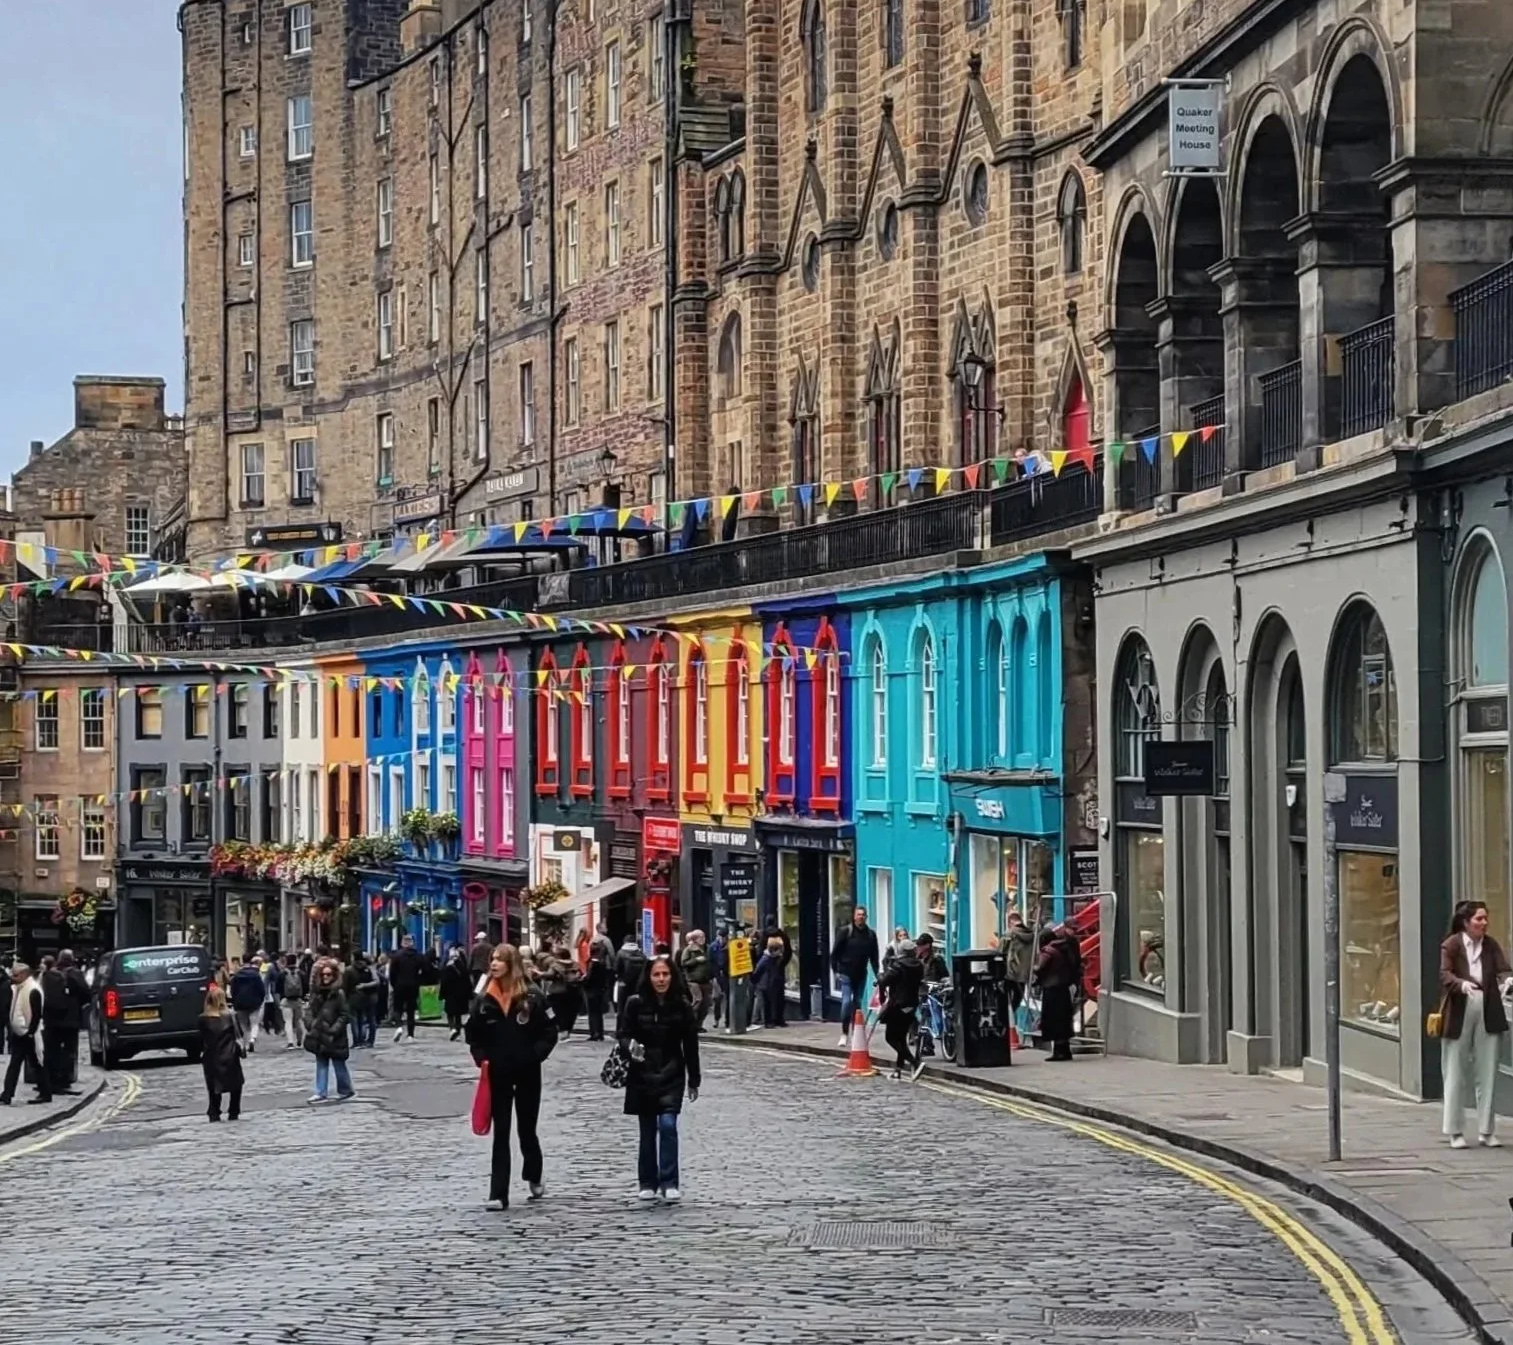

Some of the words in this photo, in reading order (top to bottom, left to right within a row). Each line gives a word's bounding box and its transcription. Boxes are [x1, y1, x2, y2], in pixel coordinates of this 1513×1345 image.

[1176, 107, 1213, 116] Quaker
[1176, 123, 1215, 135] Meeting
[1179, 140, 1211, 149] House
[694, 830, 706, 842] THE
[707, 831, 730, 845] WHISKY
[730, 832, 747, 846] SHOP
[123, 955, 199, 968] enterprise
